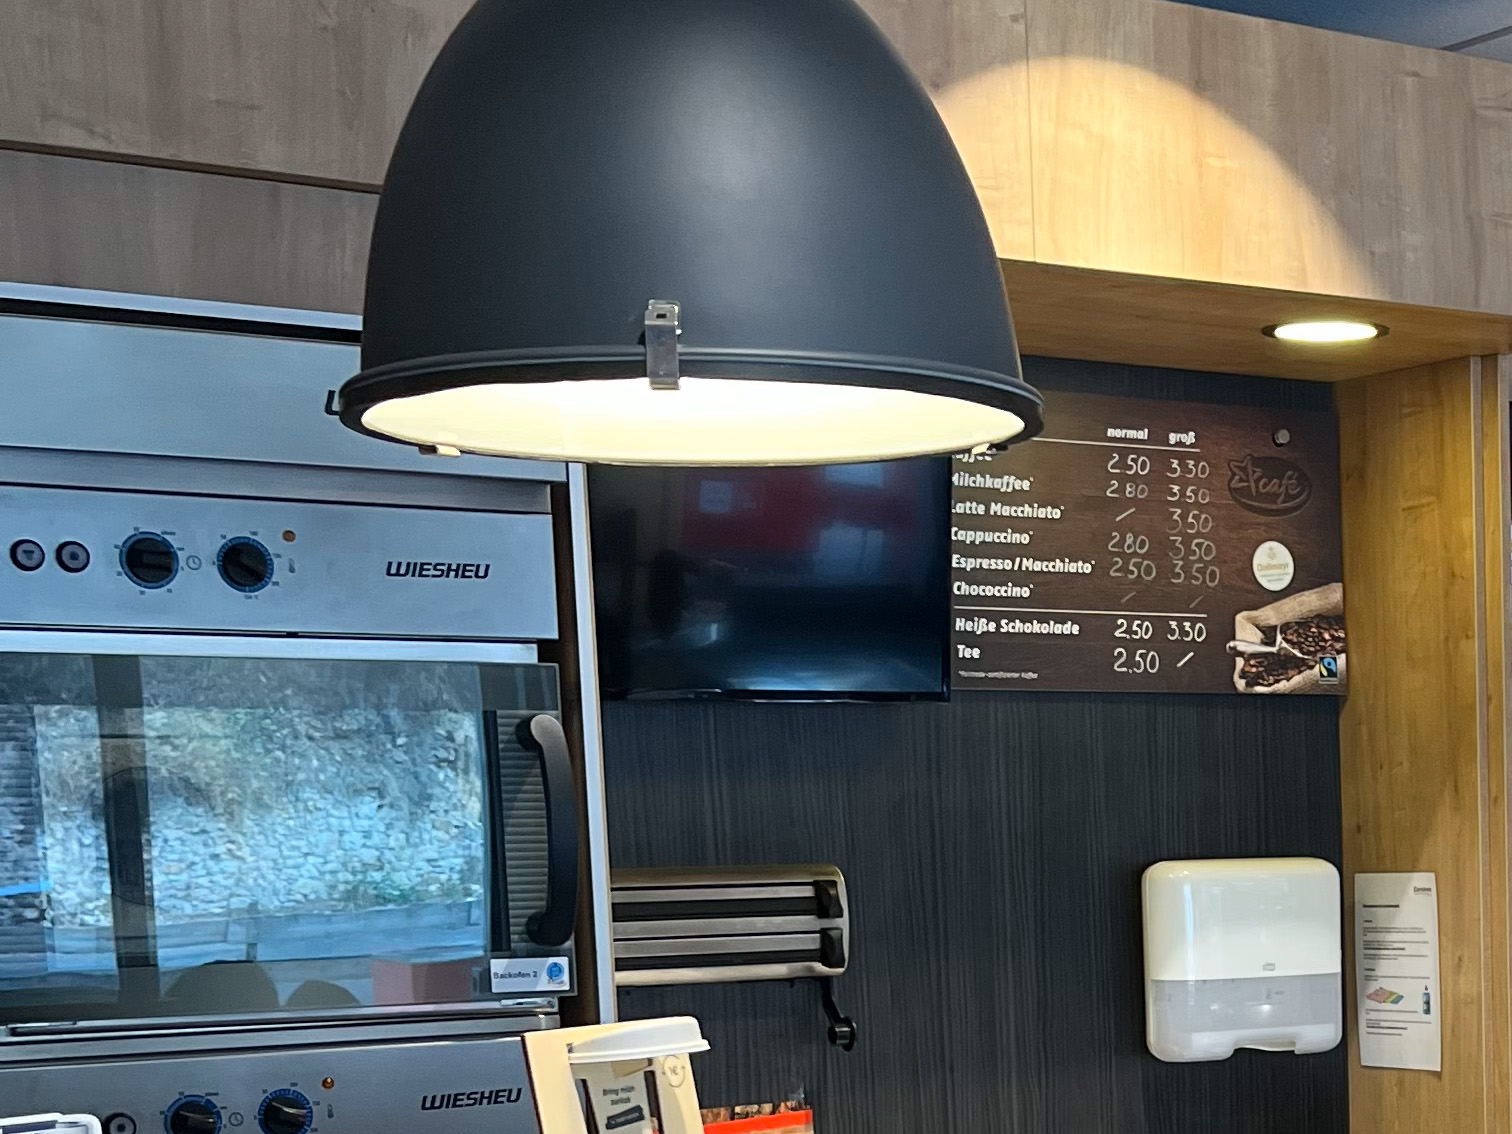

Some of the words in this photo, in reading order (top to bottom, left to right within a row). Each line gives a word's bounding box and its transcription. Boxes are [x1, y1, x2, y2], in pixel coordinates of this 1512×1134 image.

[1107, 427, 1149, 441] normal
[1168, 430, 1196, 444] groß
[385, 560, 491, 580] WIESHEU
[955, 617, 997, 635] Heiße
[1000, 617, 1080, 635] Schokolade
[957, 644, 981, 659] Tee
[493, 971, 531, 980] Backofen
[420, 1087, 523, 1111] WIESHEU
